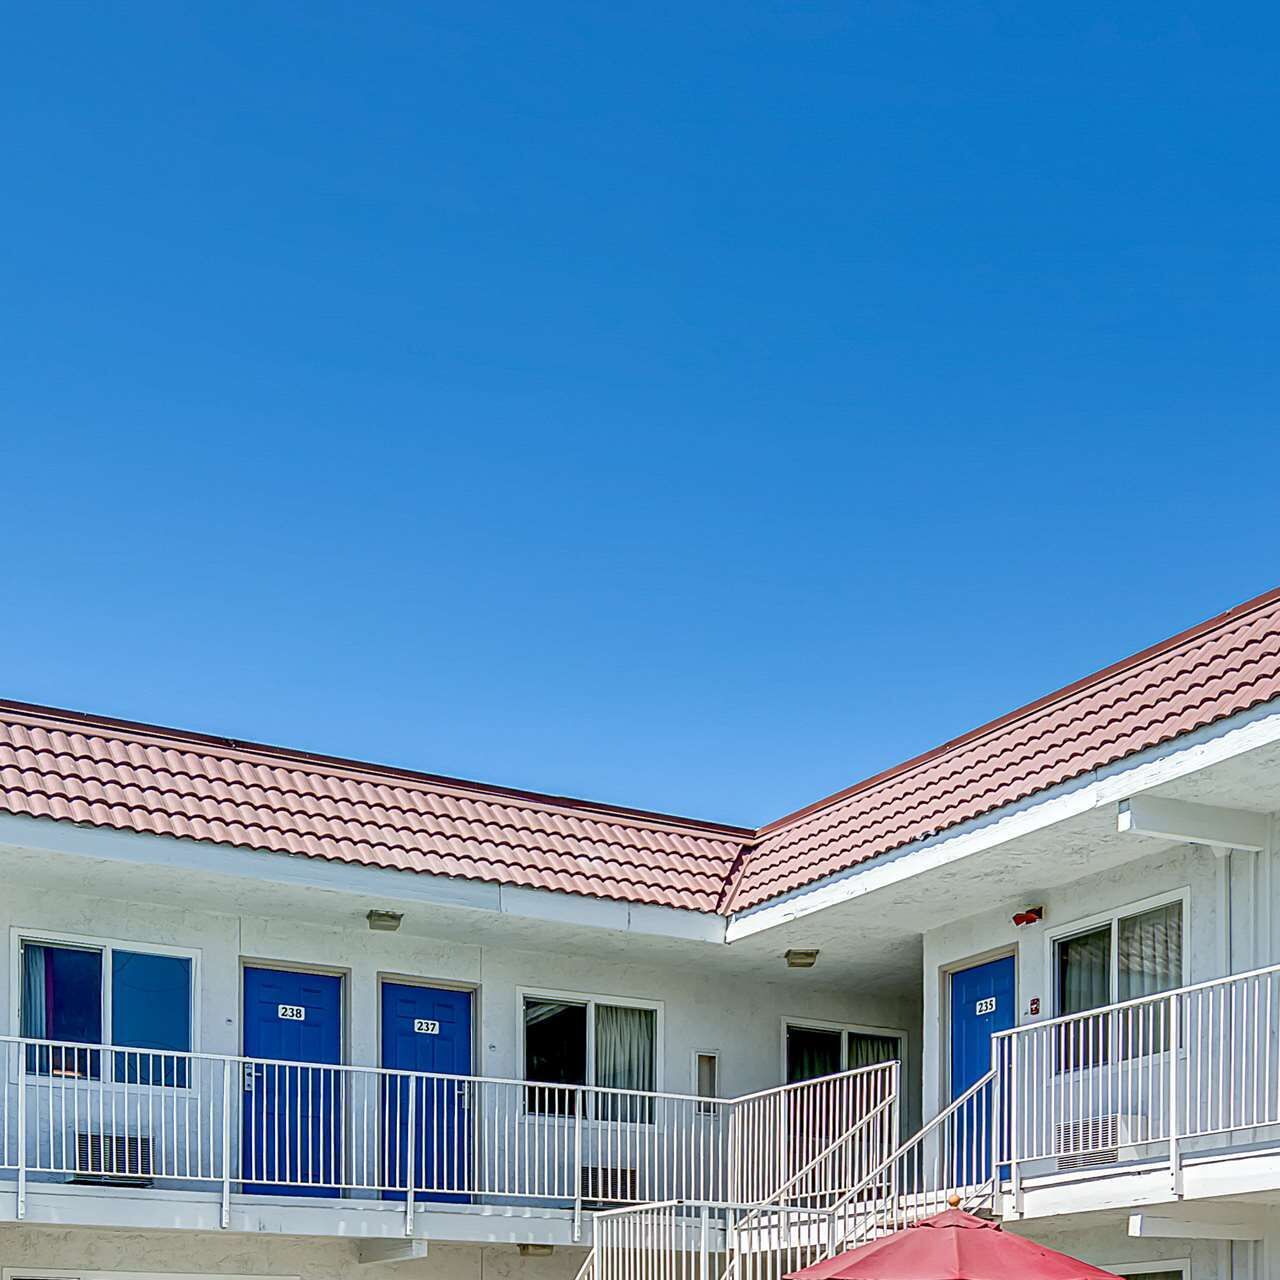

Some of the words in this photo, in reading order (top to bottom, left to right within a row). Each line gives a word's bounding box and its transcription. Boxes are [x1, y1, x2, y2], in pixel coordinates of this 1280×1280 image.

[978, 999, 994, 1013] 235
[280, 1007, 303, 1019] 238
[416, 1022, 437, 1034] 237
